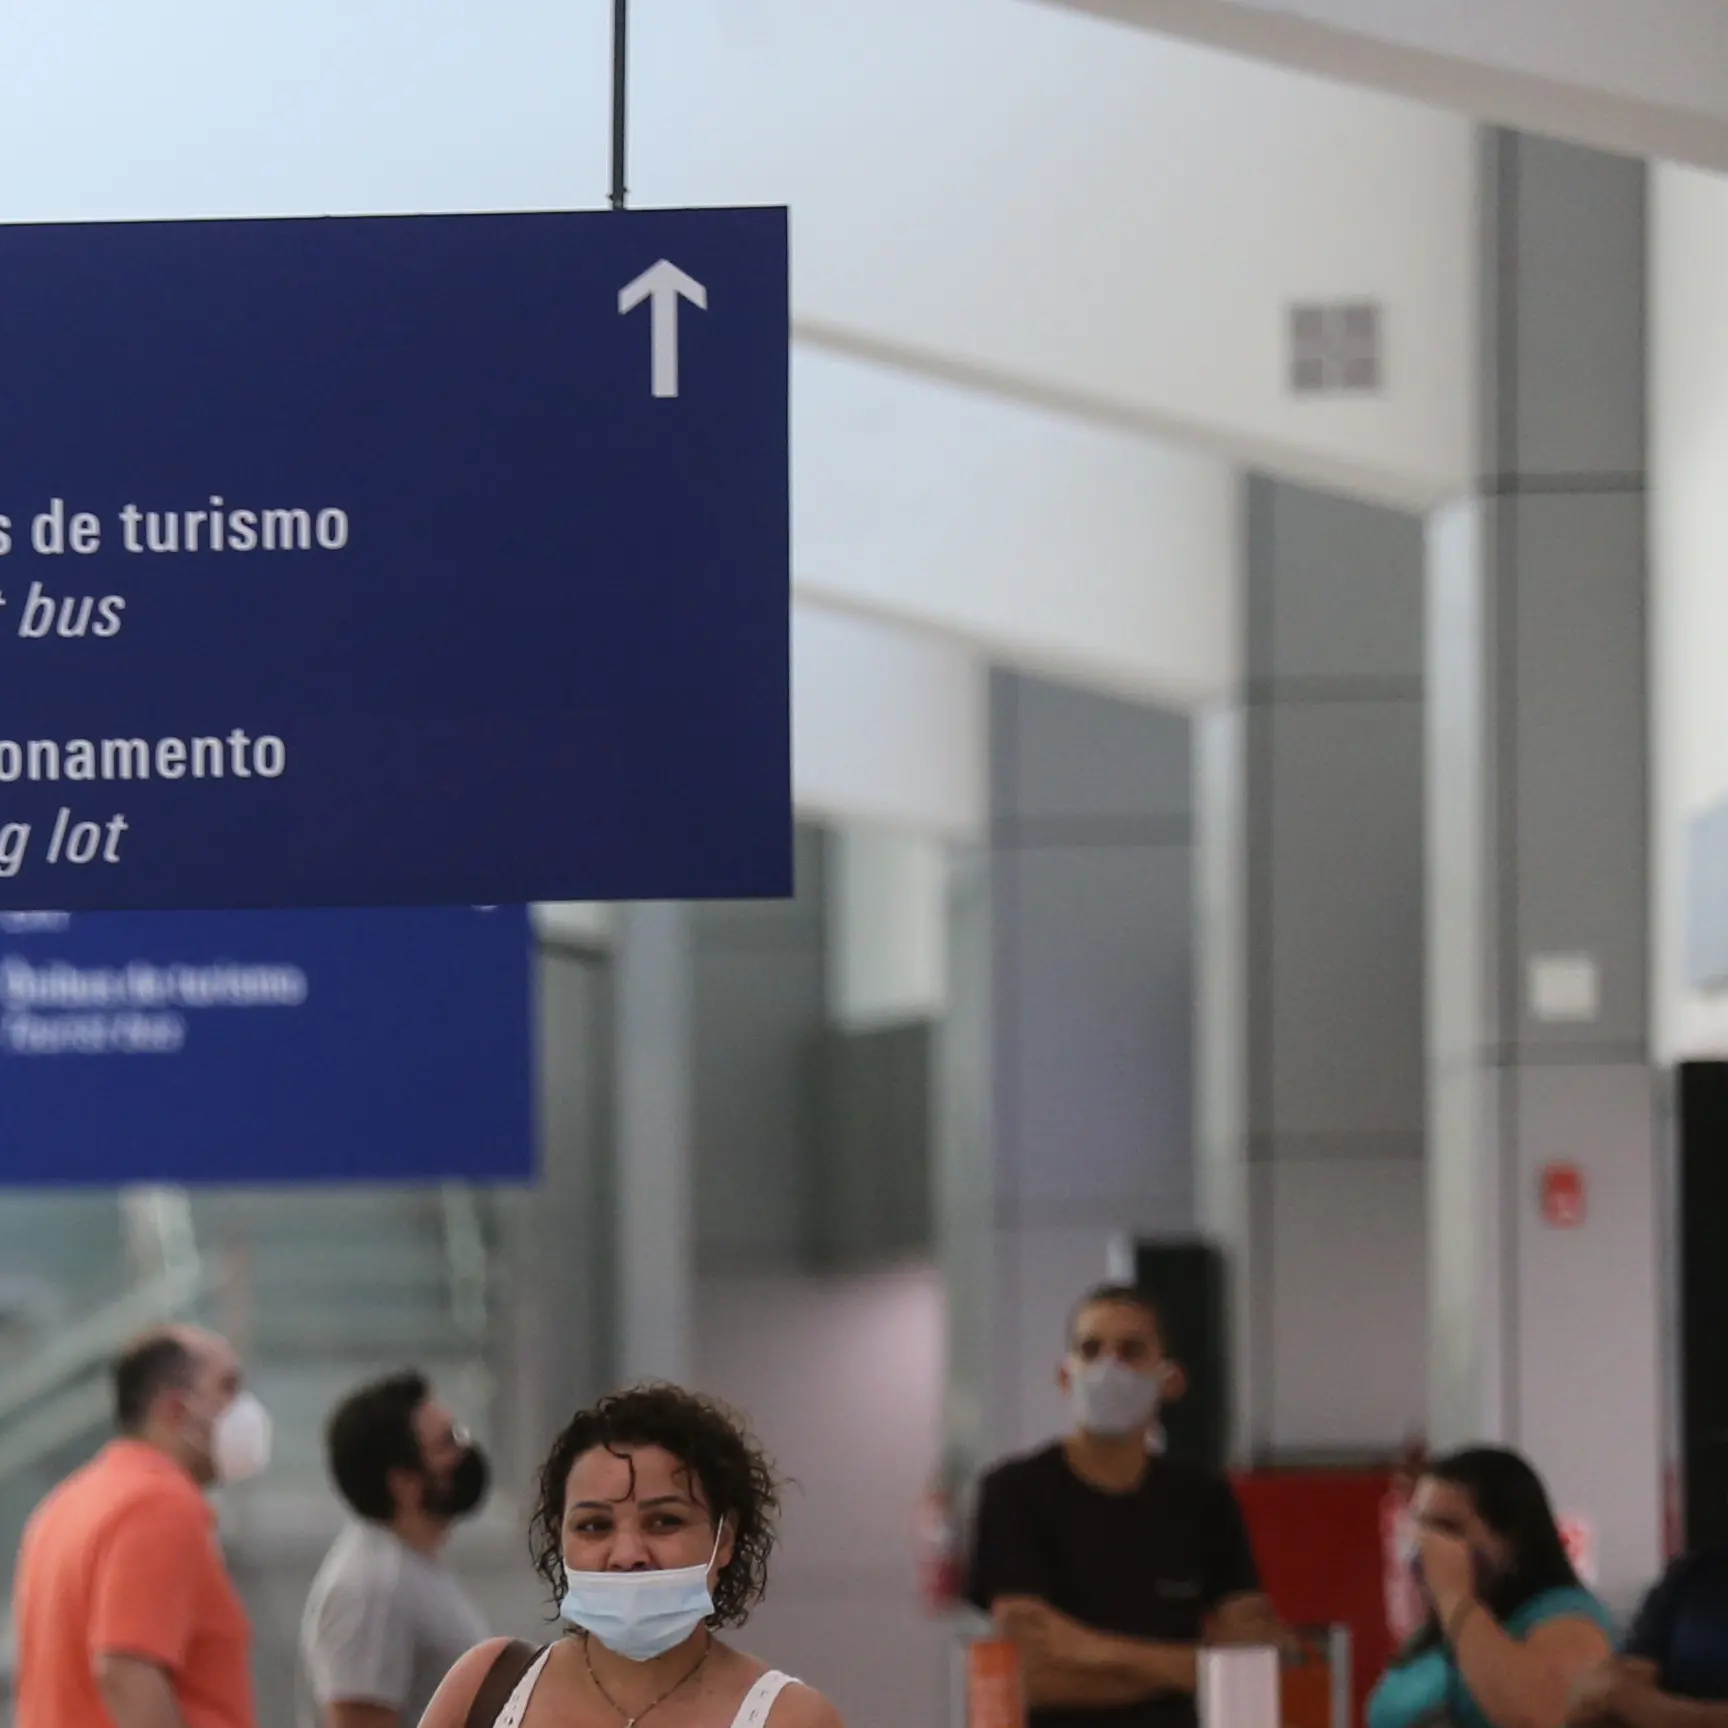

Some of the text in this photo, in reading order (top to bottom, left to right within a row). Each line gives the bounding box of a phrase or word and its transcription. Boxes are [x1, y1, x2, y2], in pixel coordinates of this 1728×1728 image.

[32, 498, 100, 554] de
[119, 496, 347, 552] turismo
[19, 582, 125, 637] bus
[47, 807, 128, 863] lot
